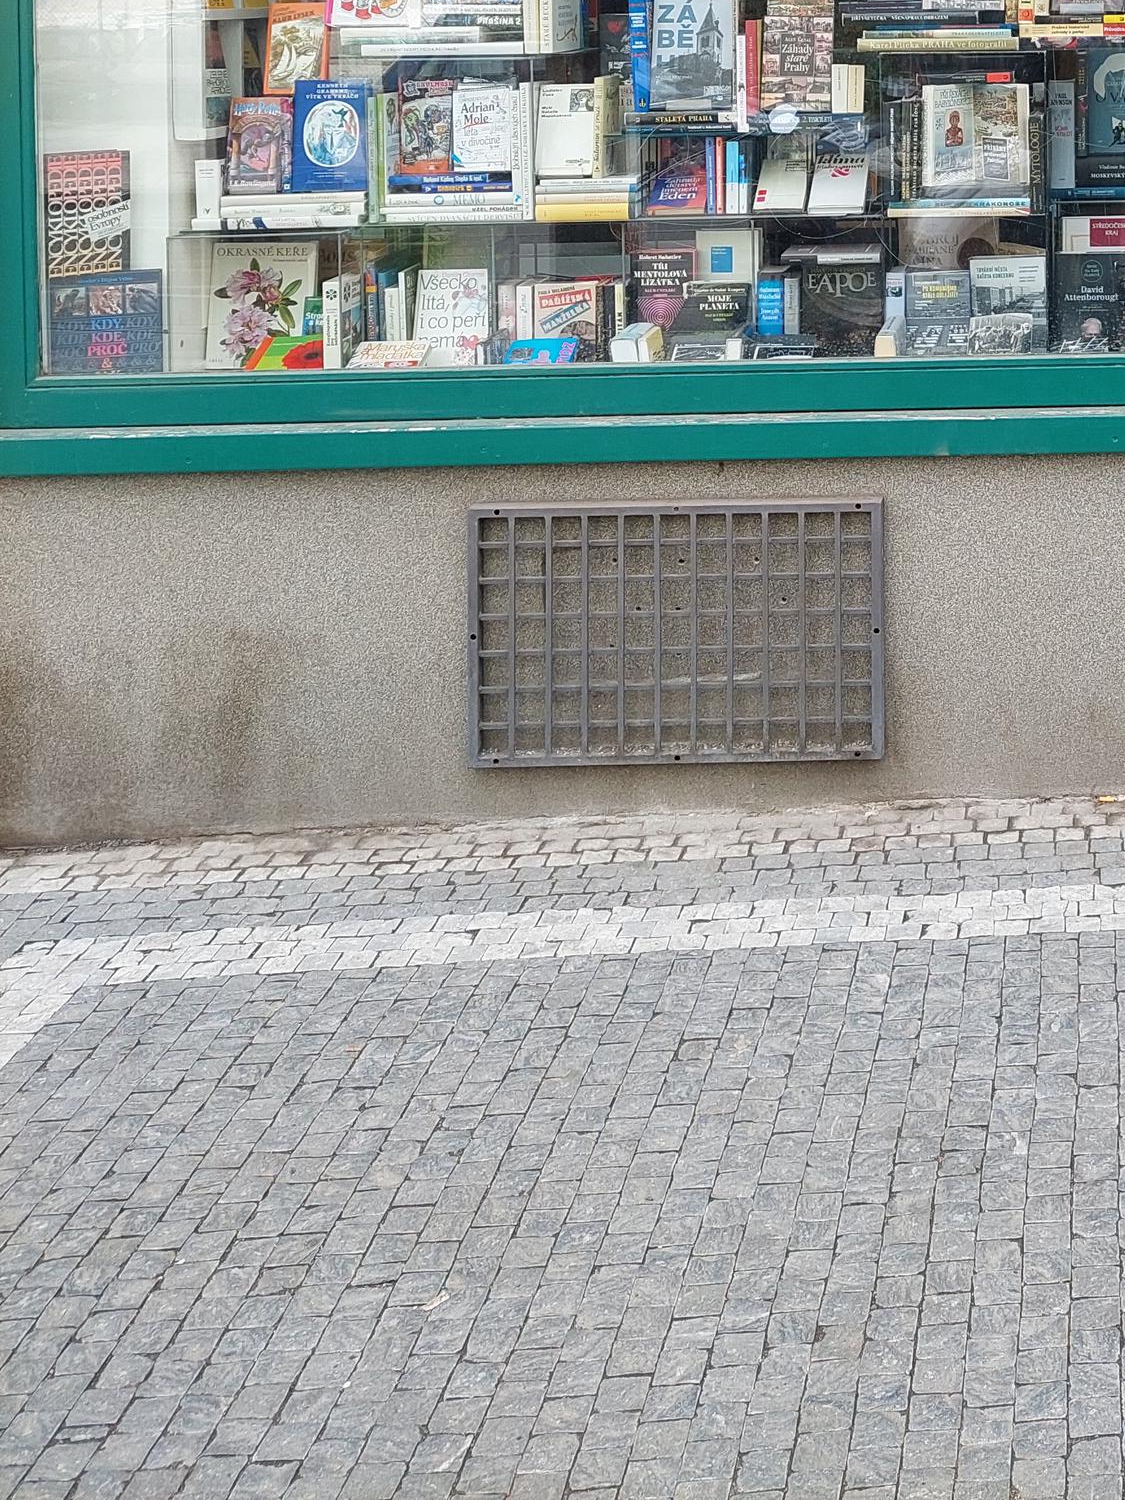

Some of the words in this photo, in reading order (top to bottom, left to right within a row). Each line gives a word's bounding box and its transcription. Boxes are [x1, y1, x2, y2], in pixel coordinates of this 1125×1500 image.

[657, 23, 694, 49] BĚ
[781, 43, 814, 55] Záhady
[922, 40, 955, 50] PRAHA
[785, 54, 809, 63] staré
[784, 61, 810, 75] Prahy
[461, 102, 495, 114] Adrian
[463, 114, 489, 125] Mole
[655, 114, 687, 123] STALETÁ
[688, 114, 713, 122] PRAHA
[1030, 121, 1042, 185] MYTOLOGIE
[658, 192, 698, 201] Eden
[89, 215, 122, 231] Evropy
[216, 245, 275, 257] OKRASNÉ
[275, 245, 309, 257] KEŘE
[651, 261, 669, 270] TŘI
[633, 268, 688, 278] MENTOLOVÁ
[419, 273, 478, 291] Všecko
[640, 276, 680, 286] LÍZÁTKA
[1080, 285, 1104, 294] David
[421, 291, 450, 313] lítá,
[706, 294, 732, 303] MOJE
[699, 302, 740, 311] PLANETA
[90, 318, 125, 331] KDY,
[428, 317, 449, 329] co
[453, 313, 487, 333] peří
[87, 341, 128, 357] PROČ
